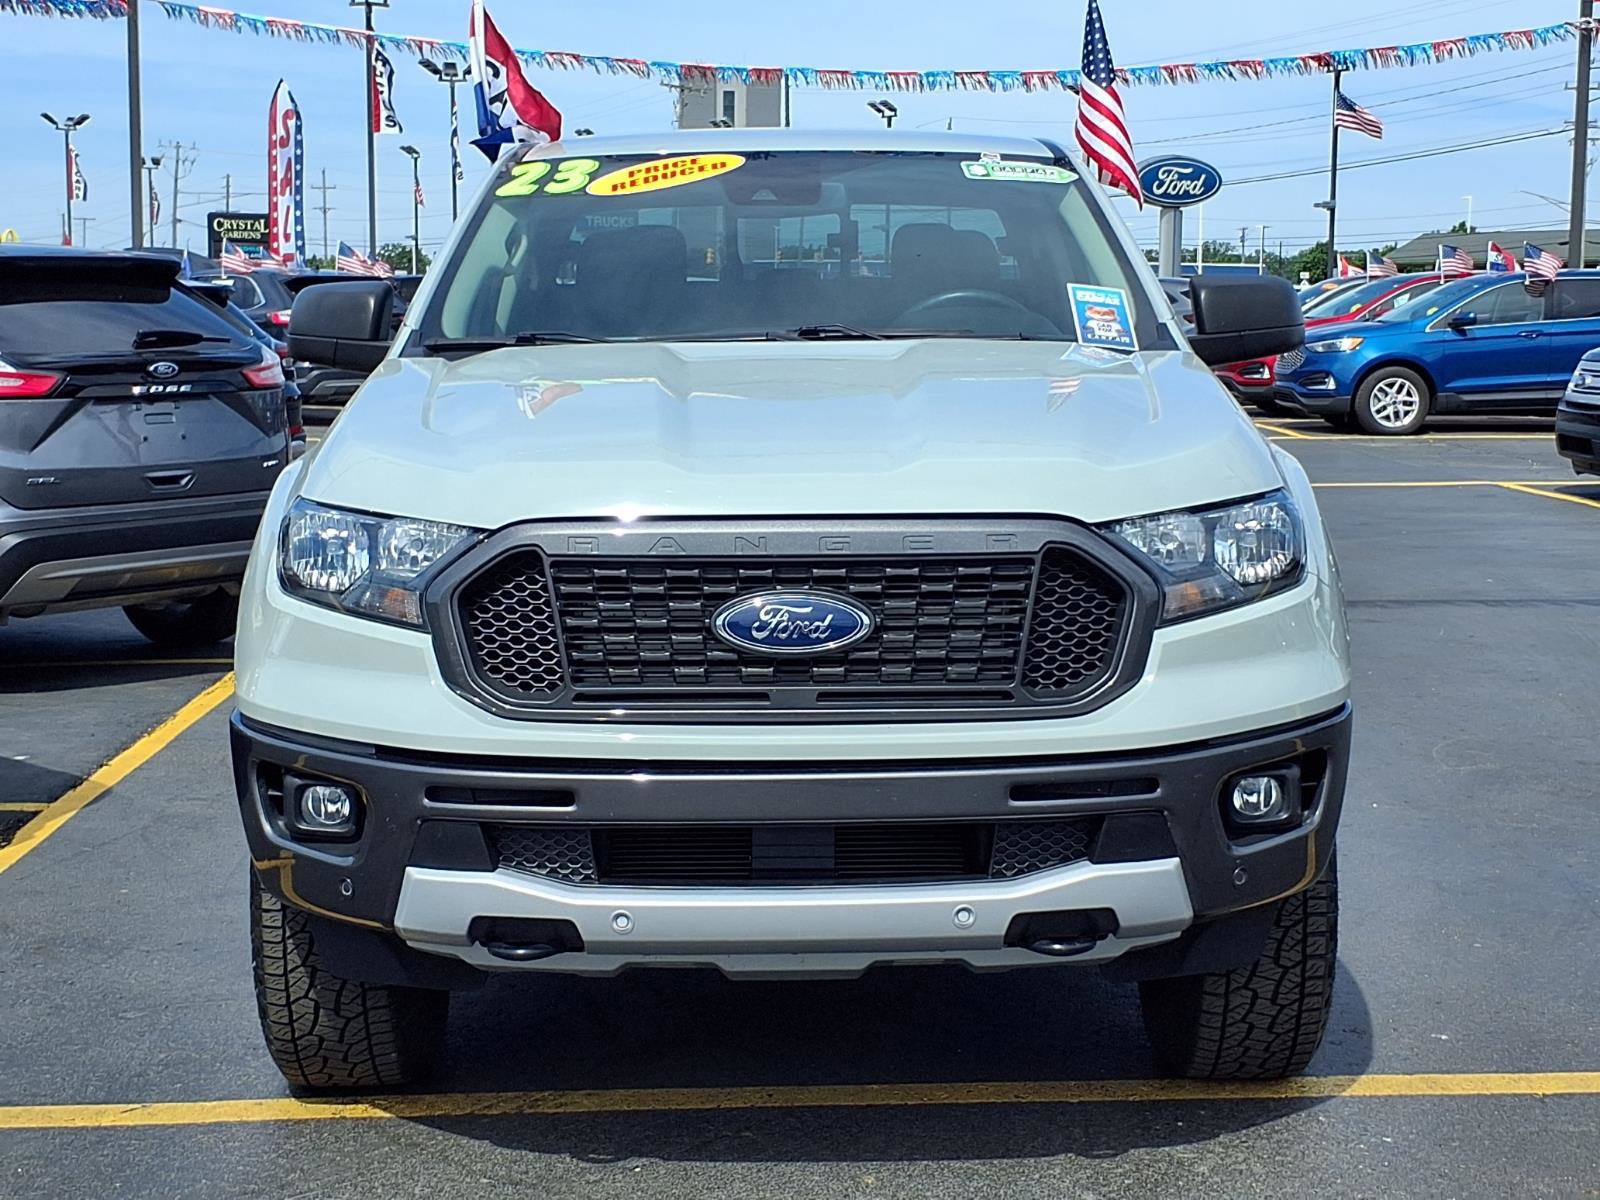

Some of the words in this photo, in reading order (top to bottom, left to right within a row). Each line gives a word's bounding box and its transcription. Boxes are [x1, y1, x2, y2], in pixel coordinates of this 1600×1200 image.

[495, 158, 600, 197] 23
[611, 161, 728, 193] REDUCED
[628, 157, 704, 178] PRICE
[1152, 166, 1206, 195] Ford
[213, 217, 270, 233] CRYSTAL
[585, 214, 635, 227] TRUCKS
[221, 231, 262, 239] GARDENS
[566, 533, 1018, 553] RANGER
[751, 604, 834, 640] Ford
